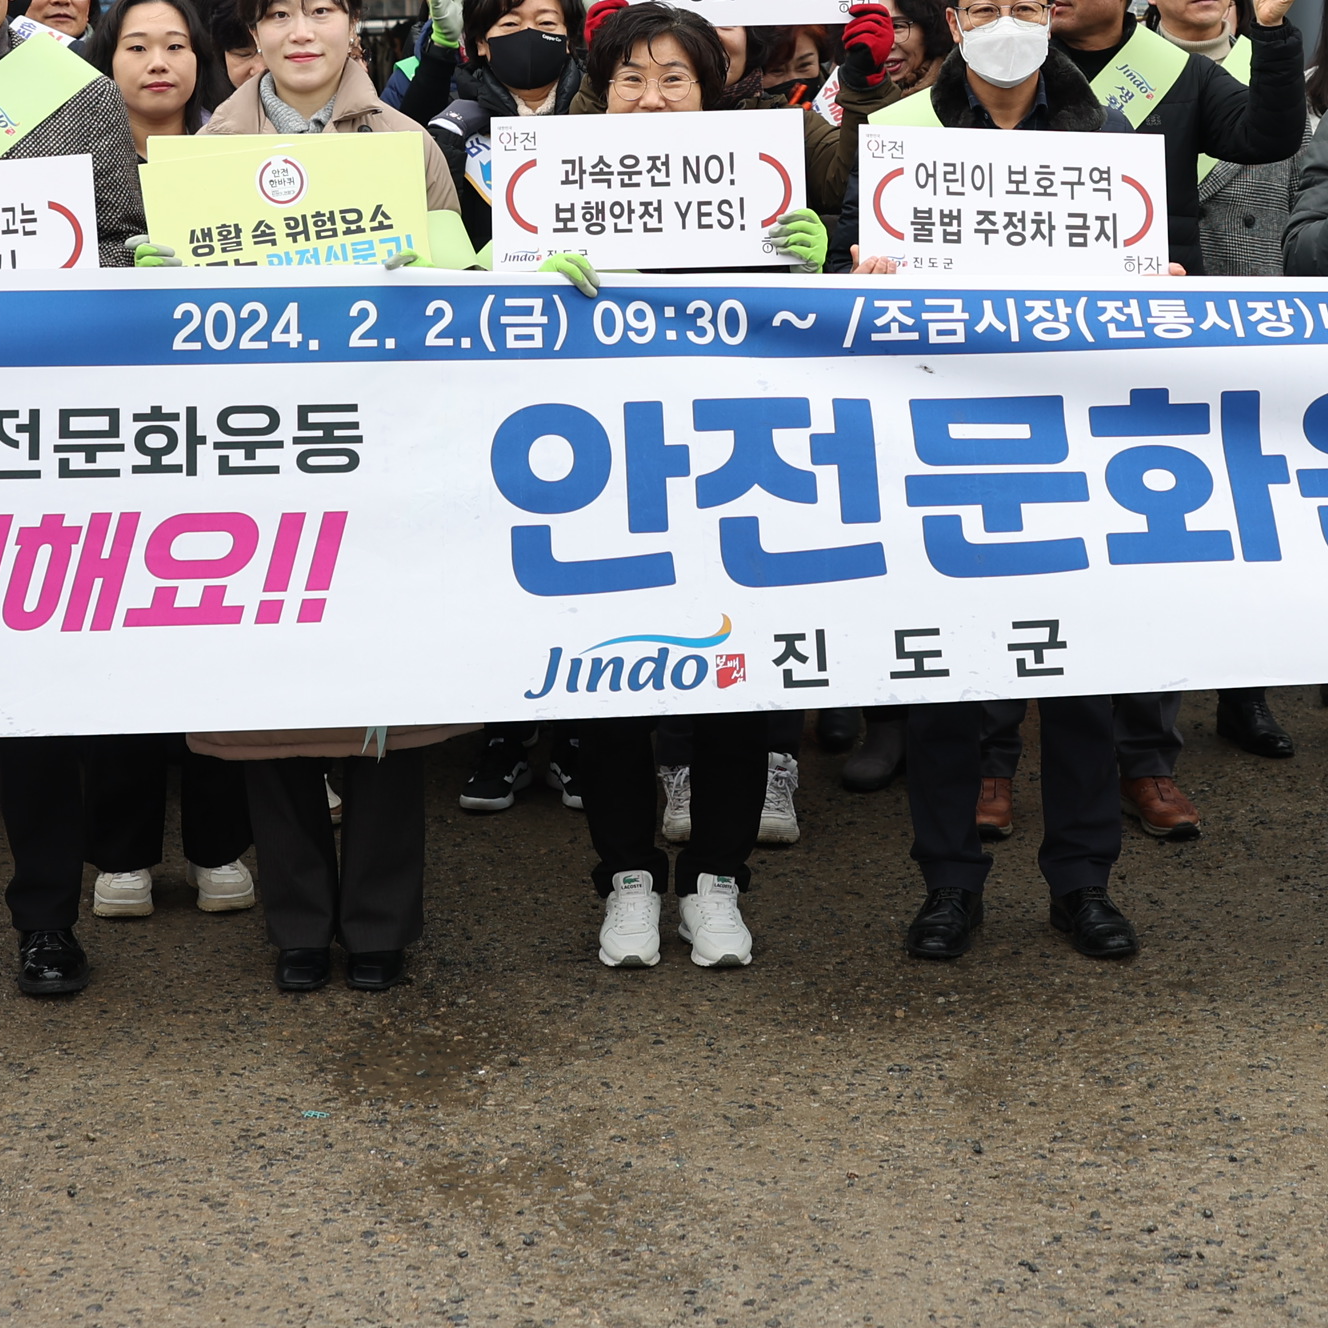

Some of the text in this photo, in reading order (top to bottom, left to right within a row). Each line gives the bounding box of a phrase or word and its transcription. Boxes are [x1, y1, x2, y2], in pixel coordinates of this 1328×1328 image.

[499, 131, 537, 151] 안전
[866, 138, 905, 159] 안전
[269, 176, 295, 189] 한바퀴
[271, 167, 289, 178] 안전
[560, 152, 735, 190] 과속운전 NO!
[915, 160, 1112, 201] 어린이 보호구역
[189, 204, 394, 258] 생활 속 위험요소
[552, 197, 746, 235] 보행안전 YES!
[910, 206, 1118, 249] 불법 주정차 금지
[501, 251, 536, 264] Jindo
[172, 301, 319, 351] 2024.
[348, 300, 396, 349] 2.
[593, 299, 748, 346] 09:30
[524, 646, 709, 700] Jindo
